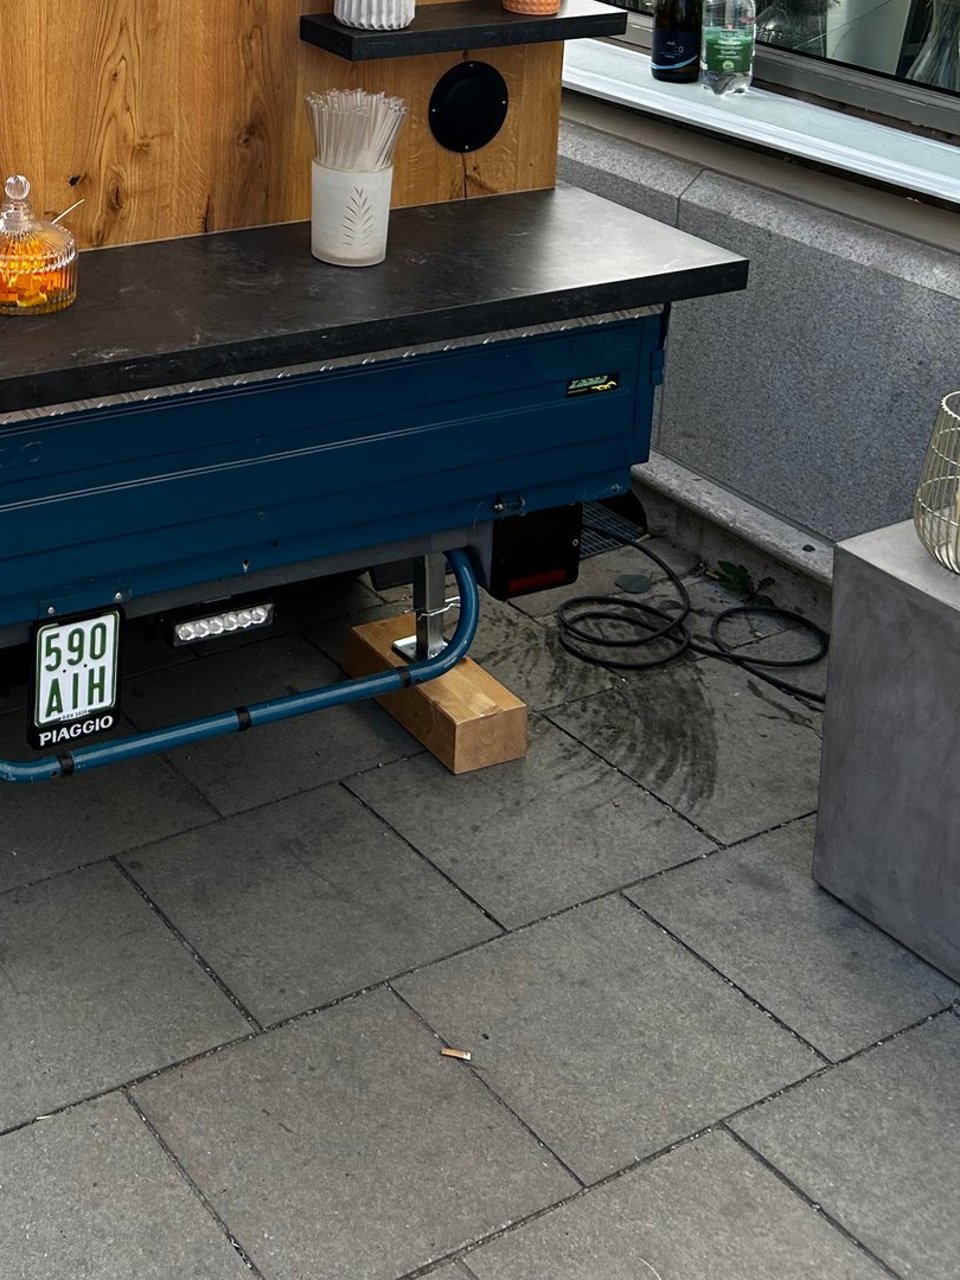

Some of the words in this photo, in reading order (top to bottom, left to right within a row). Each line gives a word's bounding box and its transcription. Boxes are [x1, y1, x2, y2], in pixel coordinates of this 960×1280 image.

[44, 622, 107, 672] 590
[44, 665, 106, 718] AIH
[39, 715, 113, 746] PIAGGIO
